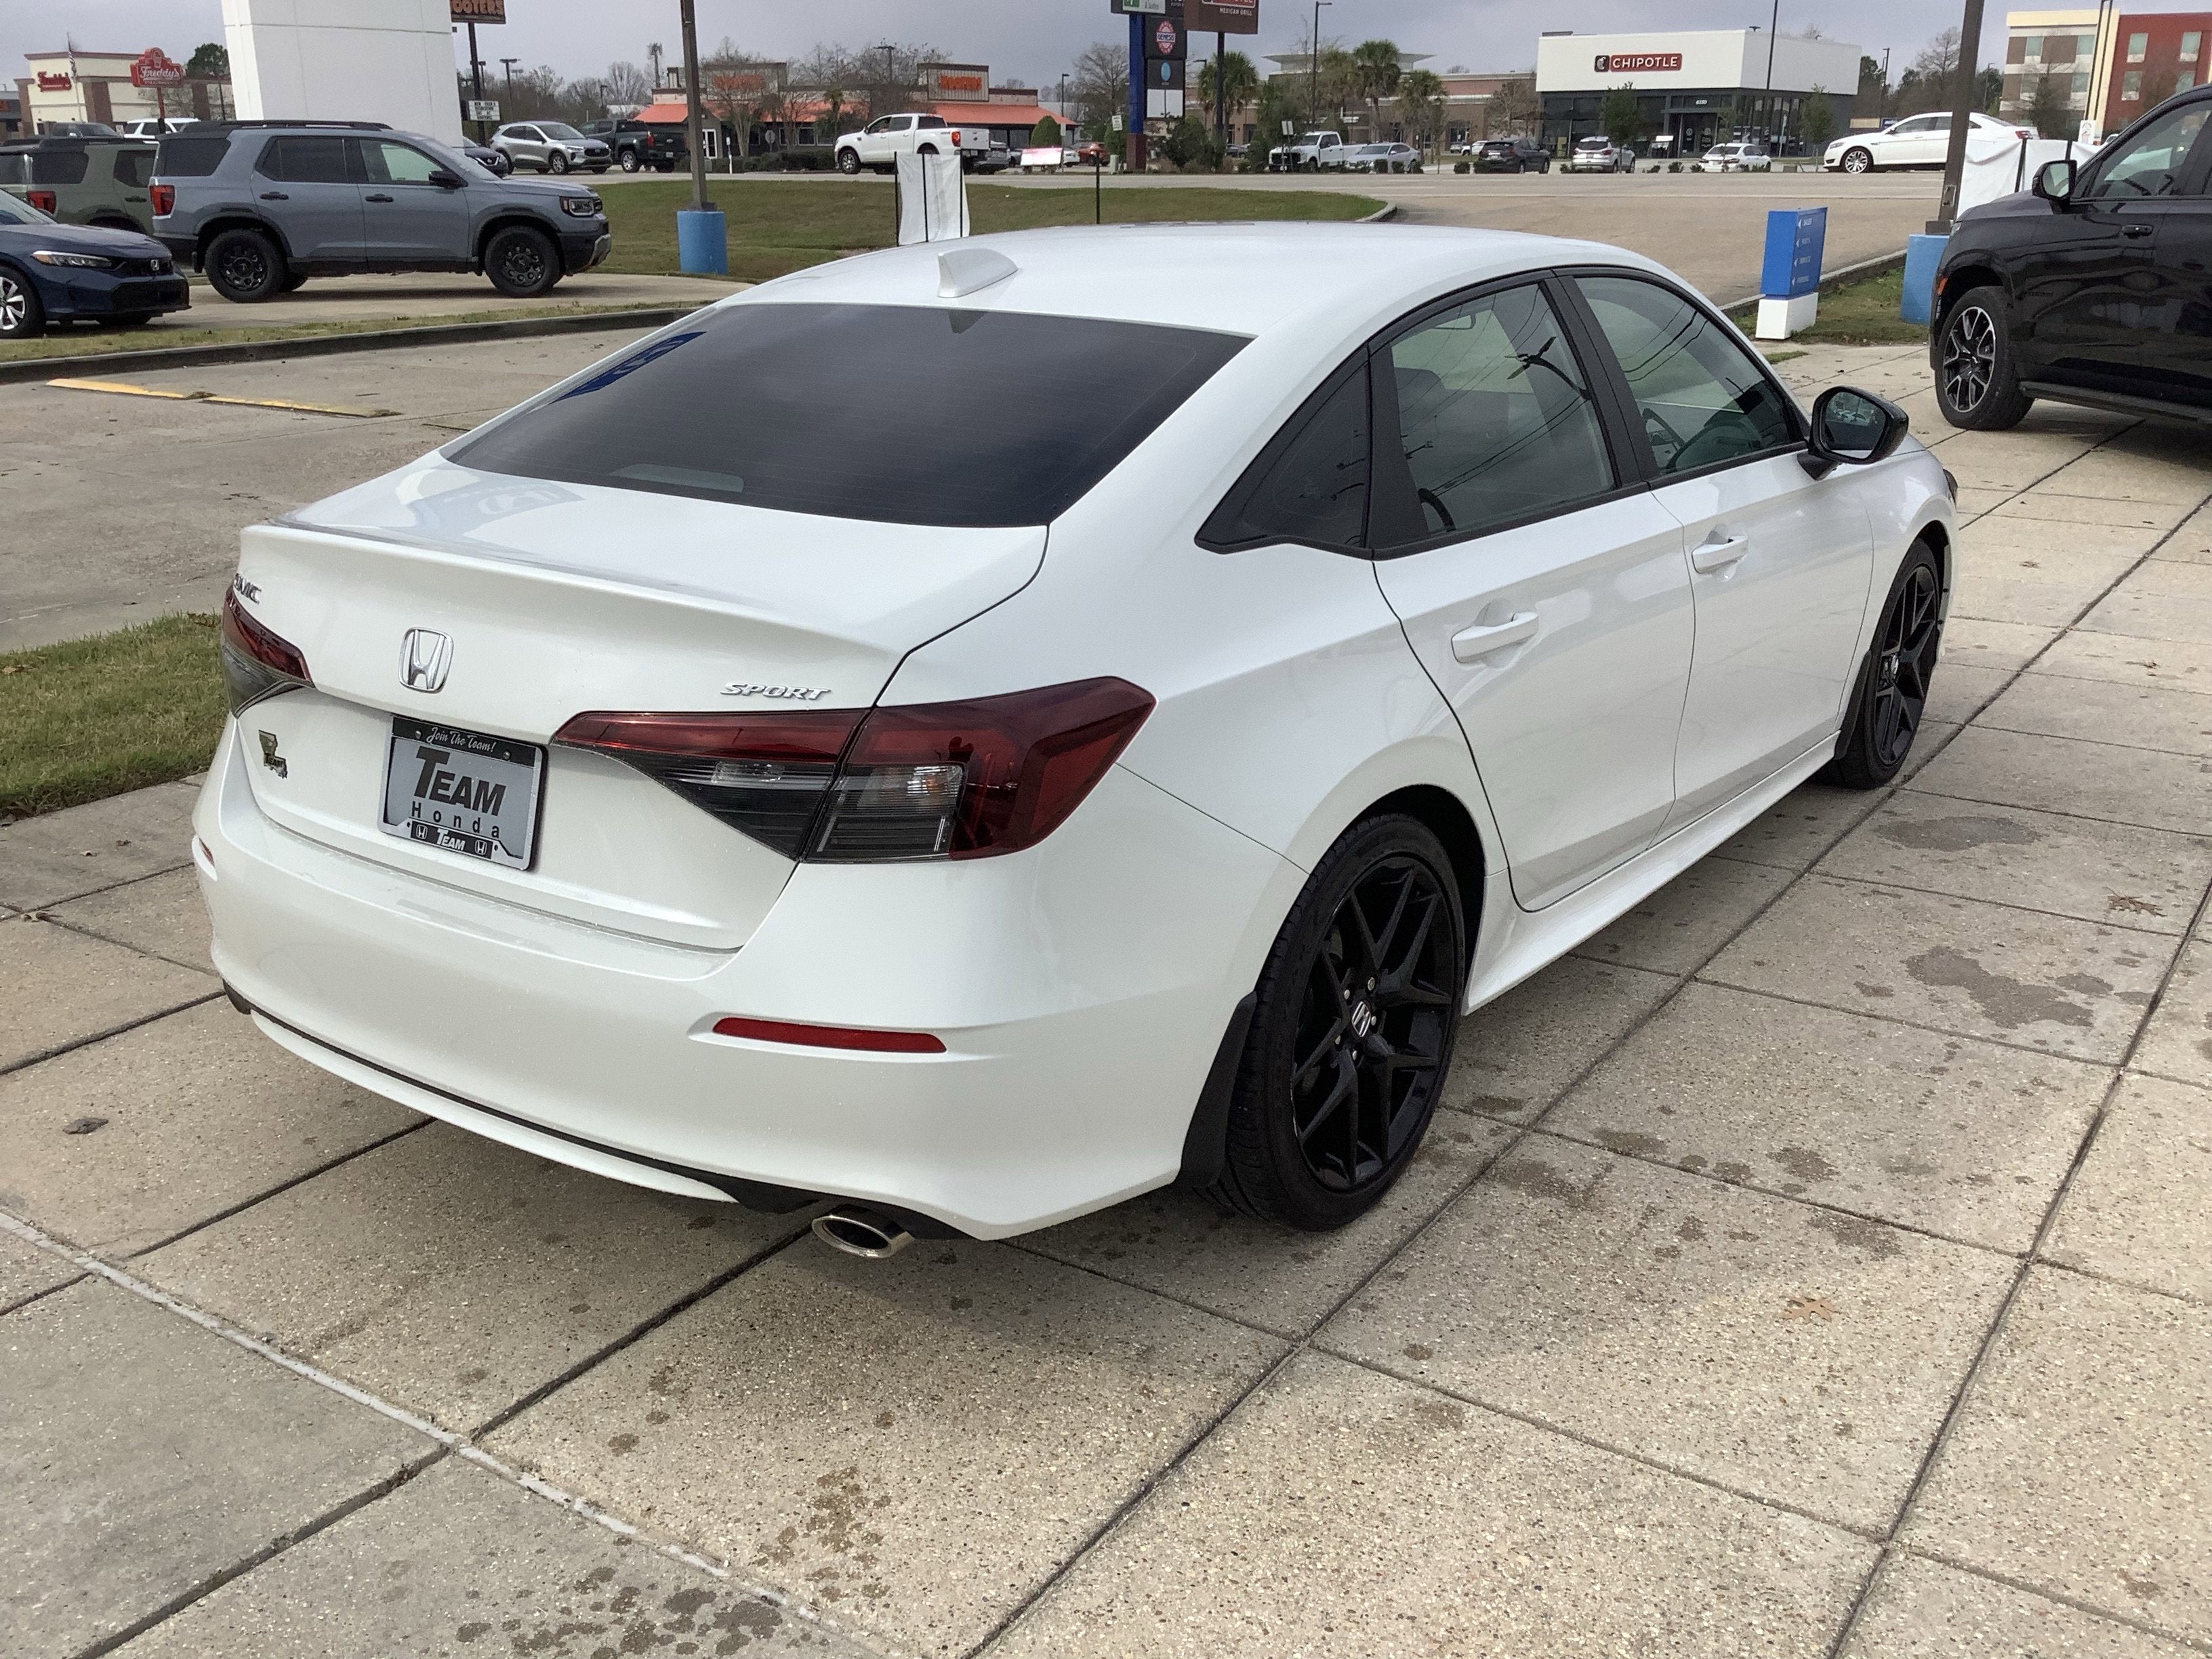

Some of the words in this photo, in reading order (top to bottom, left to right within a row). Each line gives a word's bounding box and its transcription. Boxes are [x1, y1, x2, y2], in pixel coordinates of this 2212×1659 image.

[451, 0, 504, 14] OOTERS
[1612, 57, 1678, 68] CHIPOTLE
[720, 682, 832, 701] SPORT
[426, 727, 449, 745] Join
[450, 731, 466, 745] The
[467, 735, 497, 753] Team!
[411, 801, 500, 839] Honda
